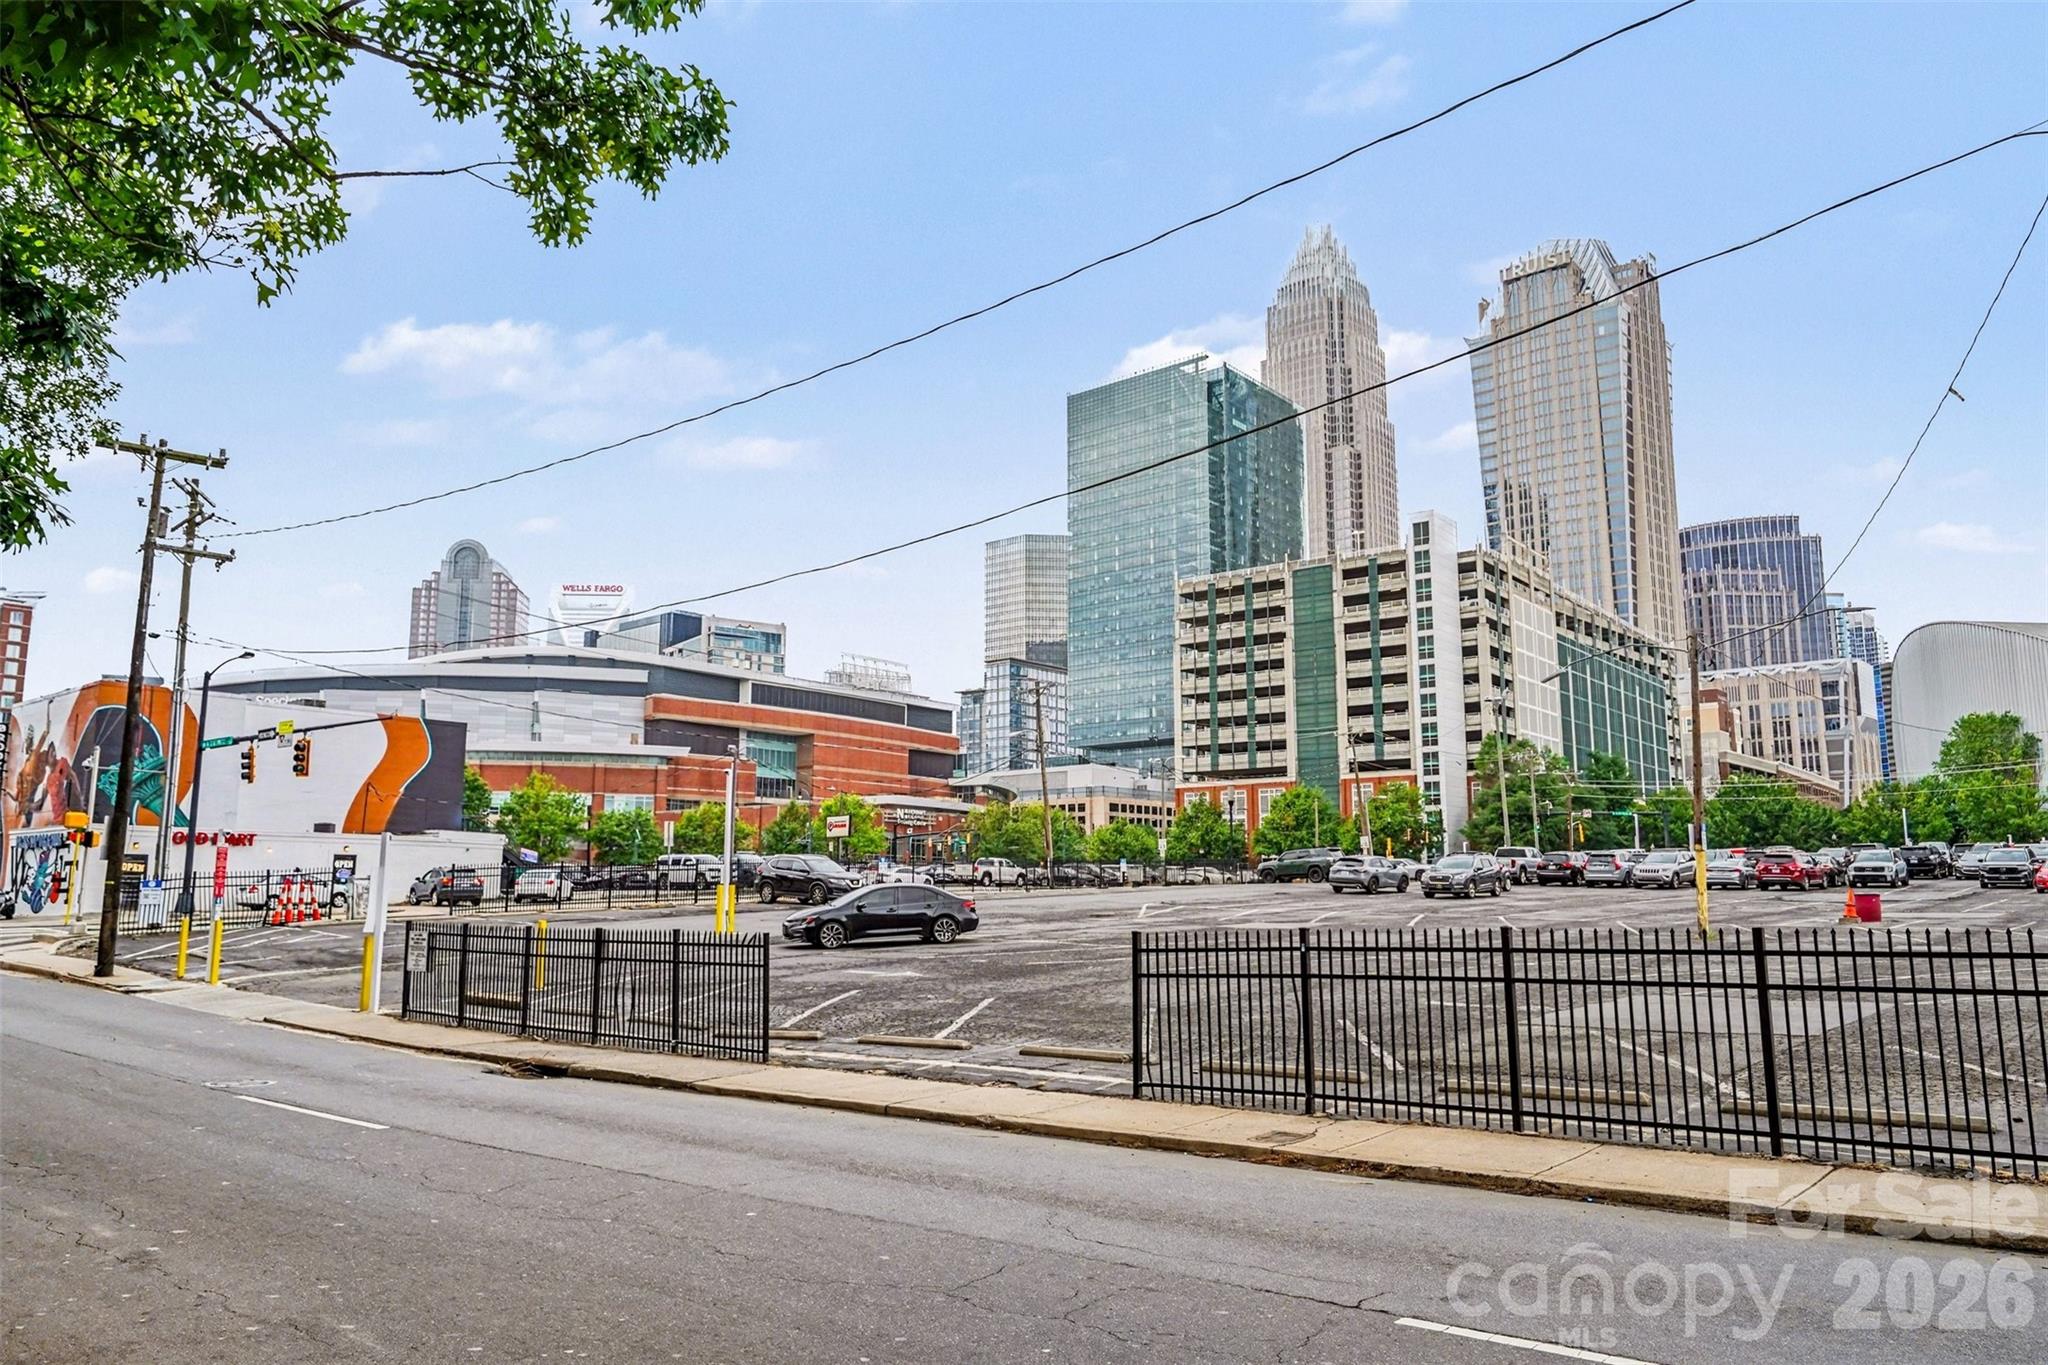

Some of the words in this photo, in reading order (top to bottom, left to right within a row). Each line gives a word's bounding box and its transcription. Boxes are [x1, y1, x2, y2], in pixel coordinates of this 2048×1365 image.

[1501, 249, 1571, 282] TRUIST
[562, 584, 592, 592] WELLS
[594, 584, 624, 592] FARGO
[121, 862, 145, 872] OPEN
